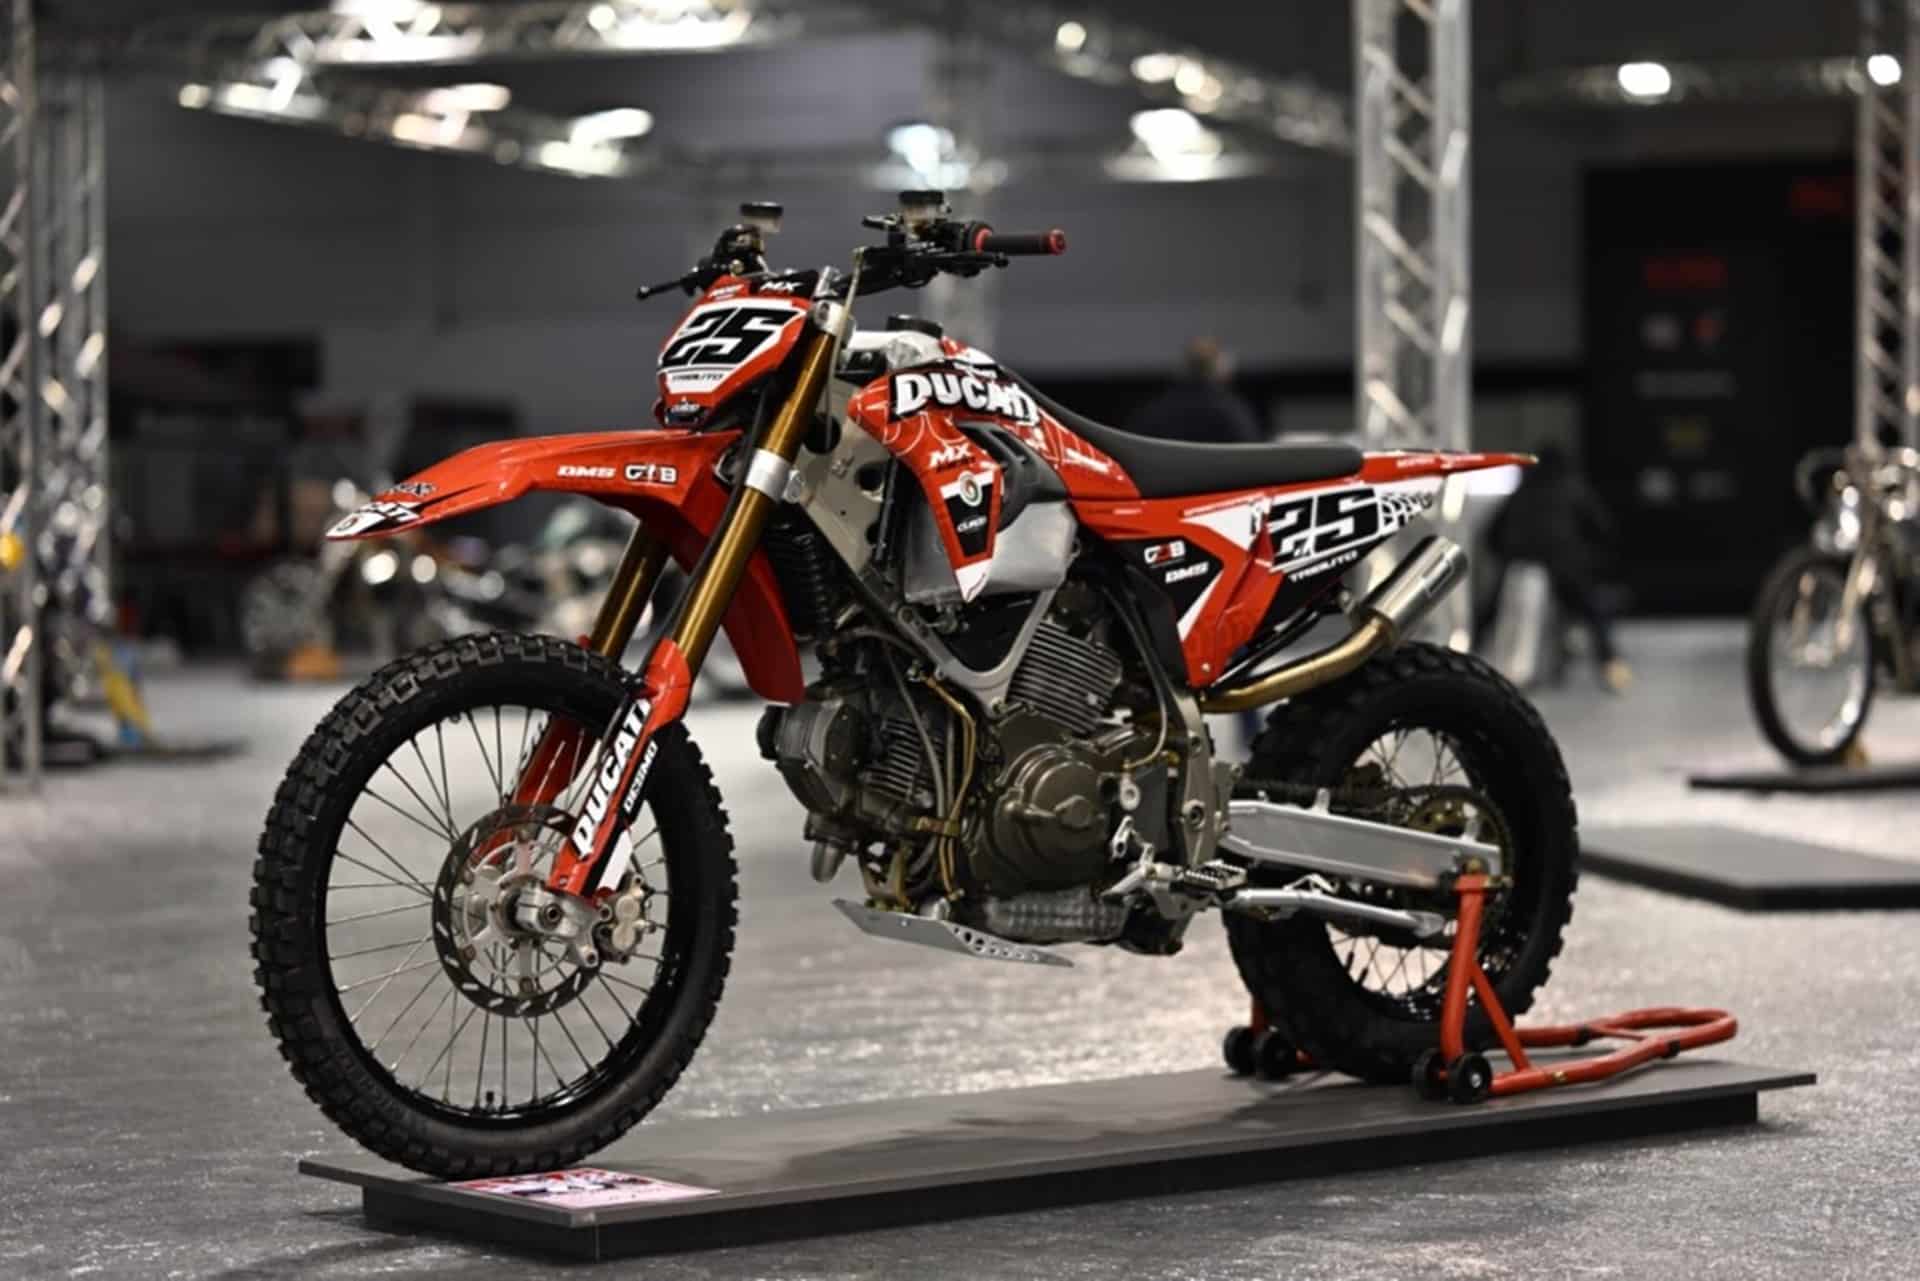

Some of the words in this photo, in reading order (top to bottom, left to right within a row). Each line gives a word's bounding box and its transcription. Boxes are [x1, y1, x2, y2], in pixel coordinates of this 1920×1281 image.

[760, 280, 804, 293] MX
[661, 307, 800, 368] 25
[929, 443, 972, 468] MX
[1260, 488, 1380, 567] 25
[572, 698, 651, 860] DUCATI
